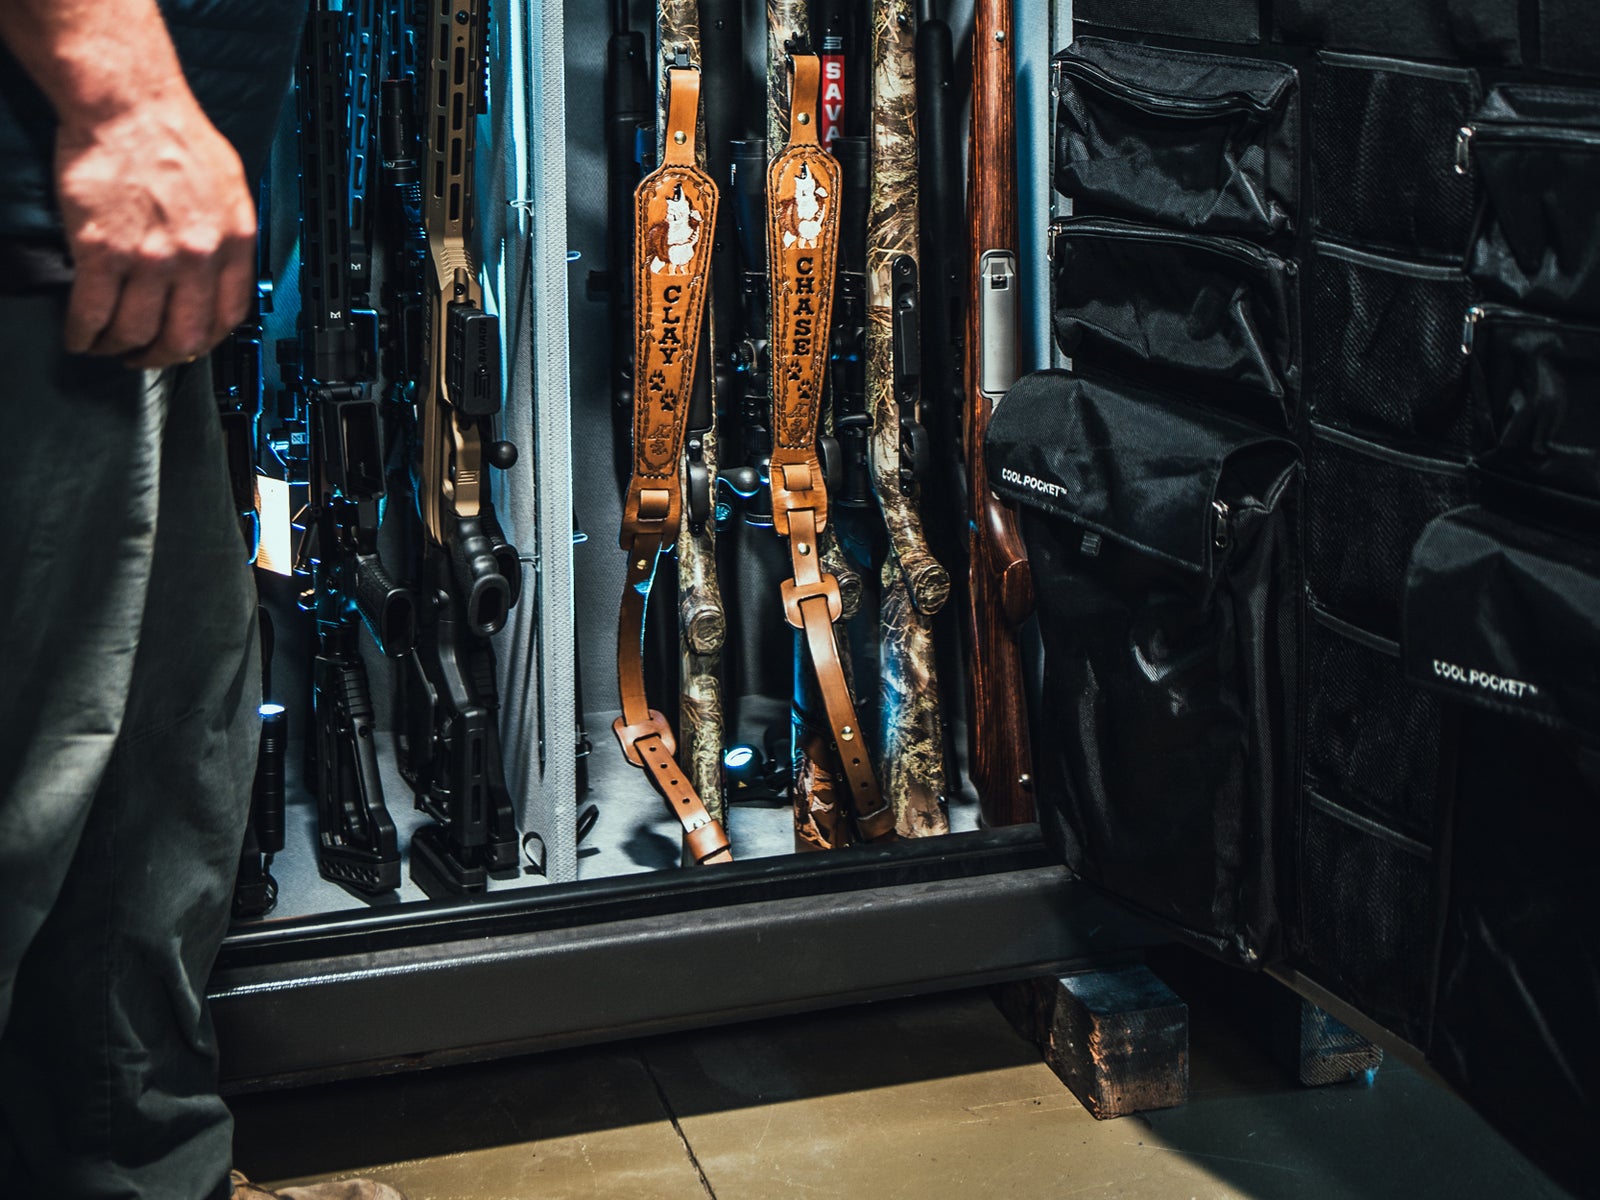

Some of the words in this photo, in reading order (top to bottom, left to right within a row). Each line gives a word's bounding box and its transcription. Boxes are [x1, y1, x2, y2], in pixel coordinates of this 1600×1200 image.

[661, 285, 682, 366] CLAY
[792, 257, 816, 357] CHASE
[1002, 467, 1023, 485] COOL
[1433, 658, 1467, 683] COOL
